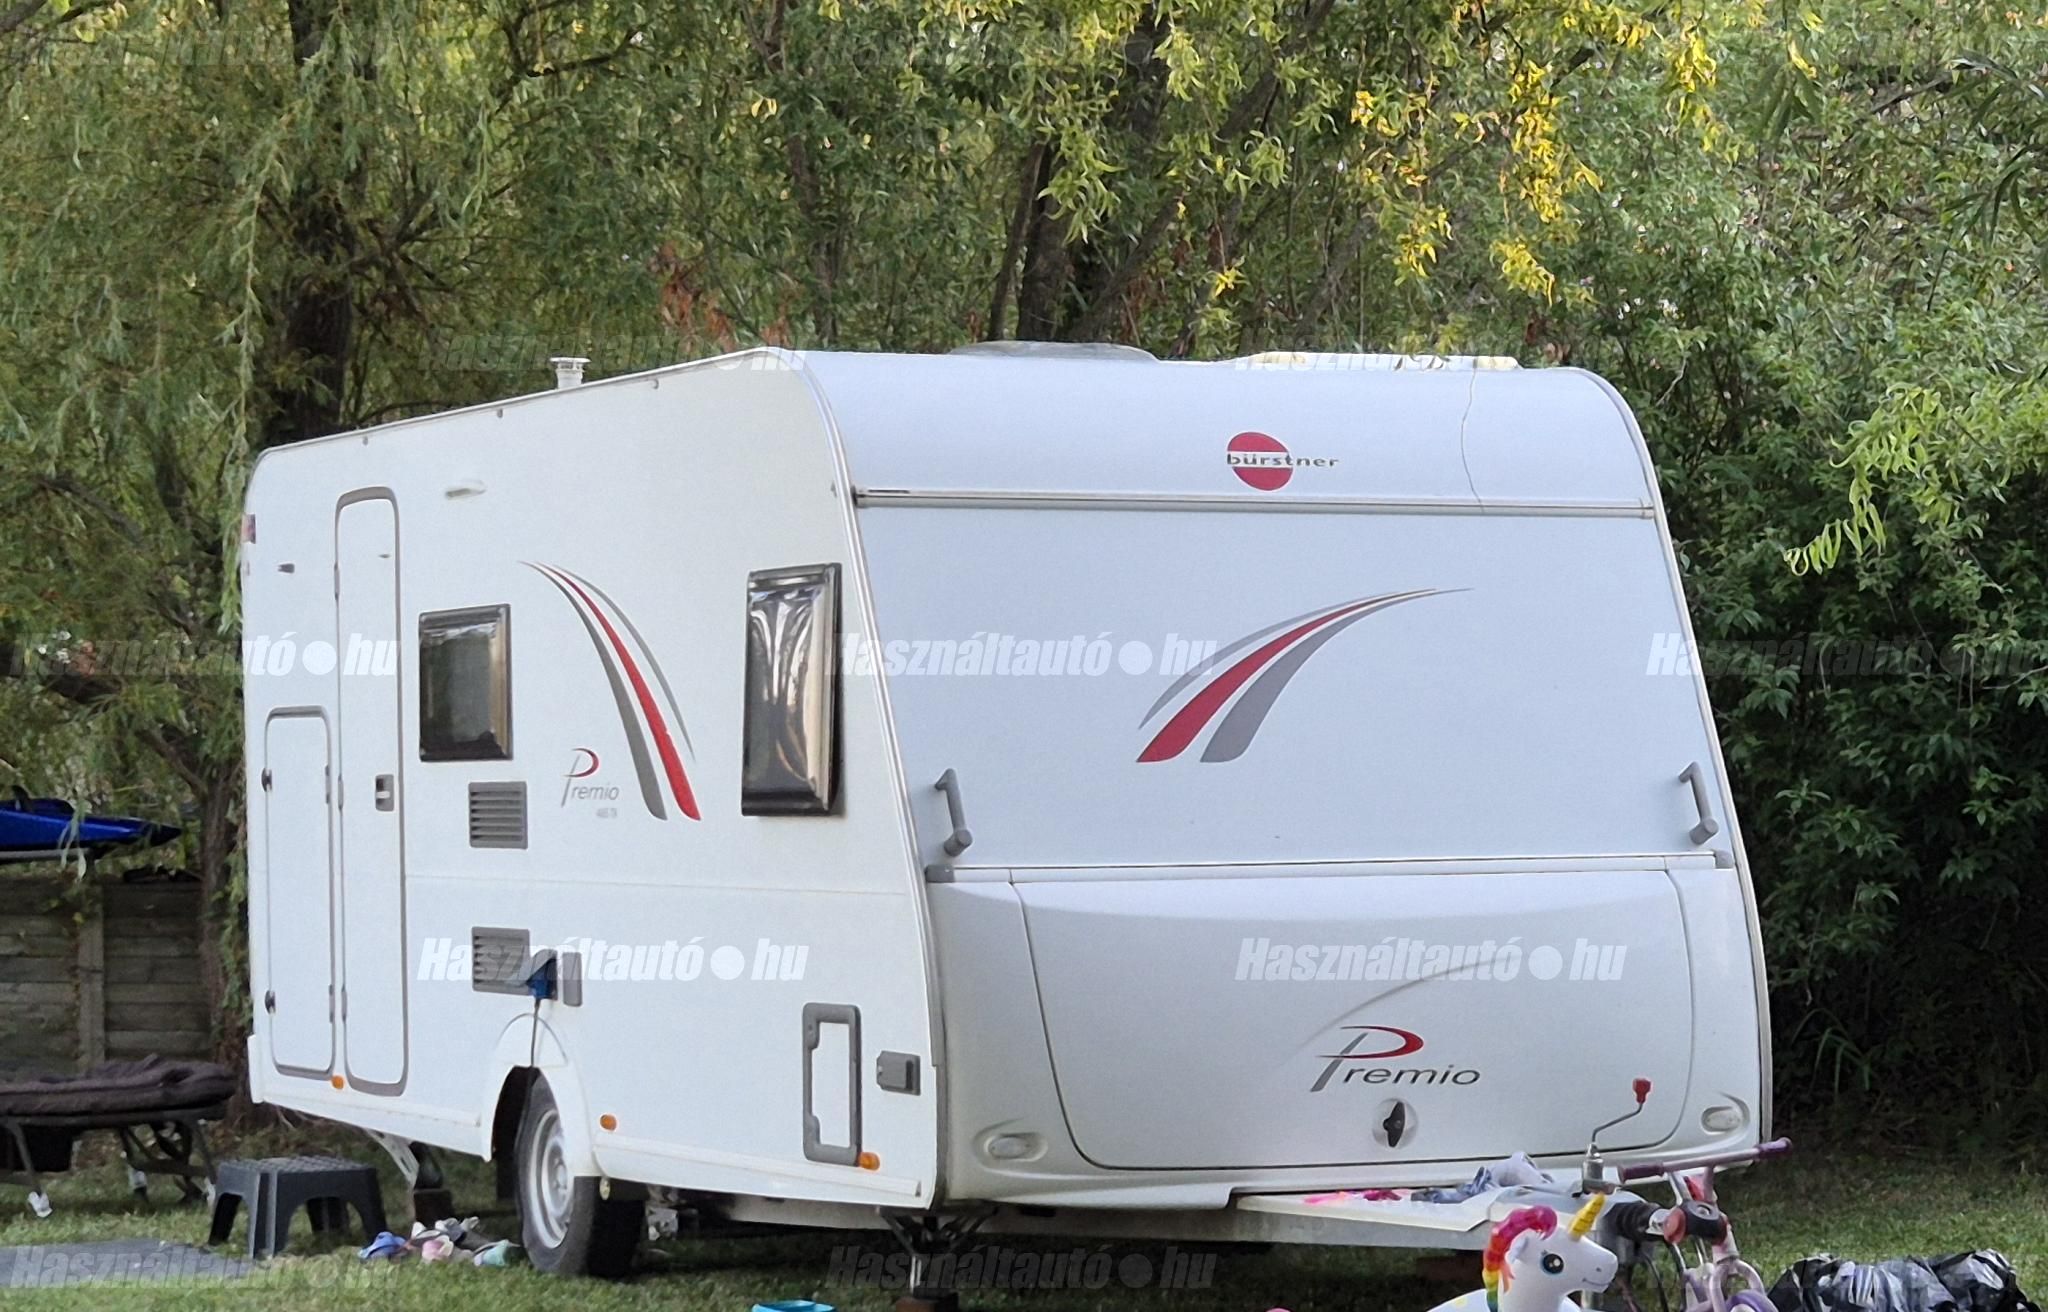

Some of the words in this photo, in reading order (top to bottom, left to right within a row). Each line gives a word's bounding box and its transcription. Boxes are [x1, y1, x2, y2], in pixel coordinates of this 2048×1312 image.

[1226, 453, 1340, 467] bürstner
[561, 747, 620, 808] Premio
[1310, 1025, 1481, 1092] Premio
